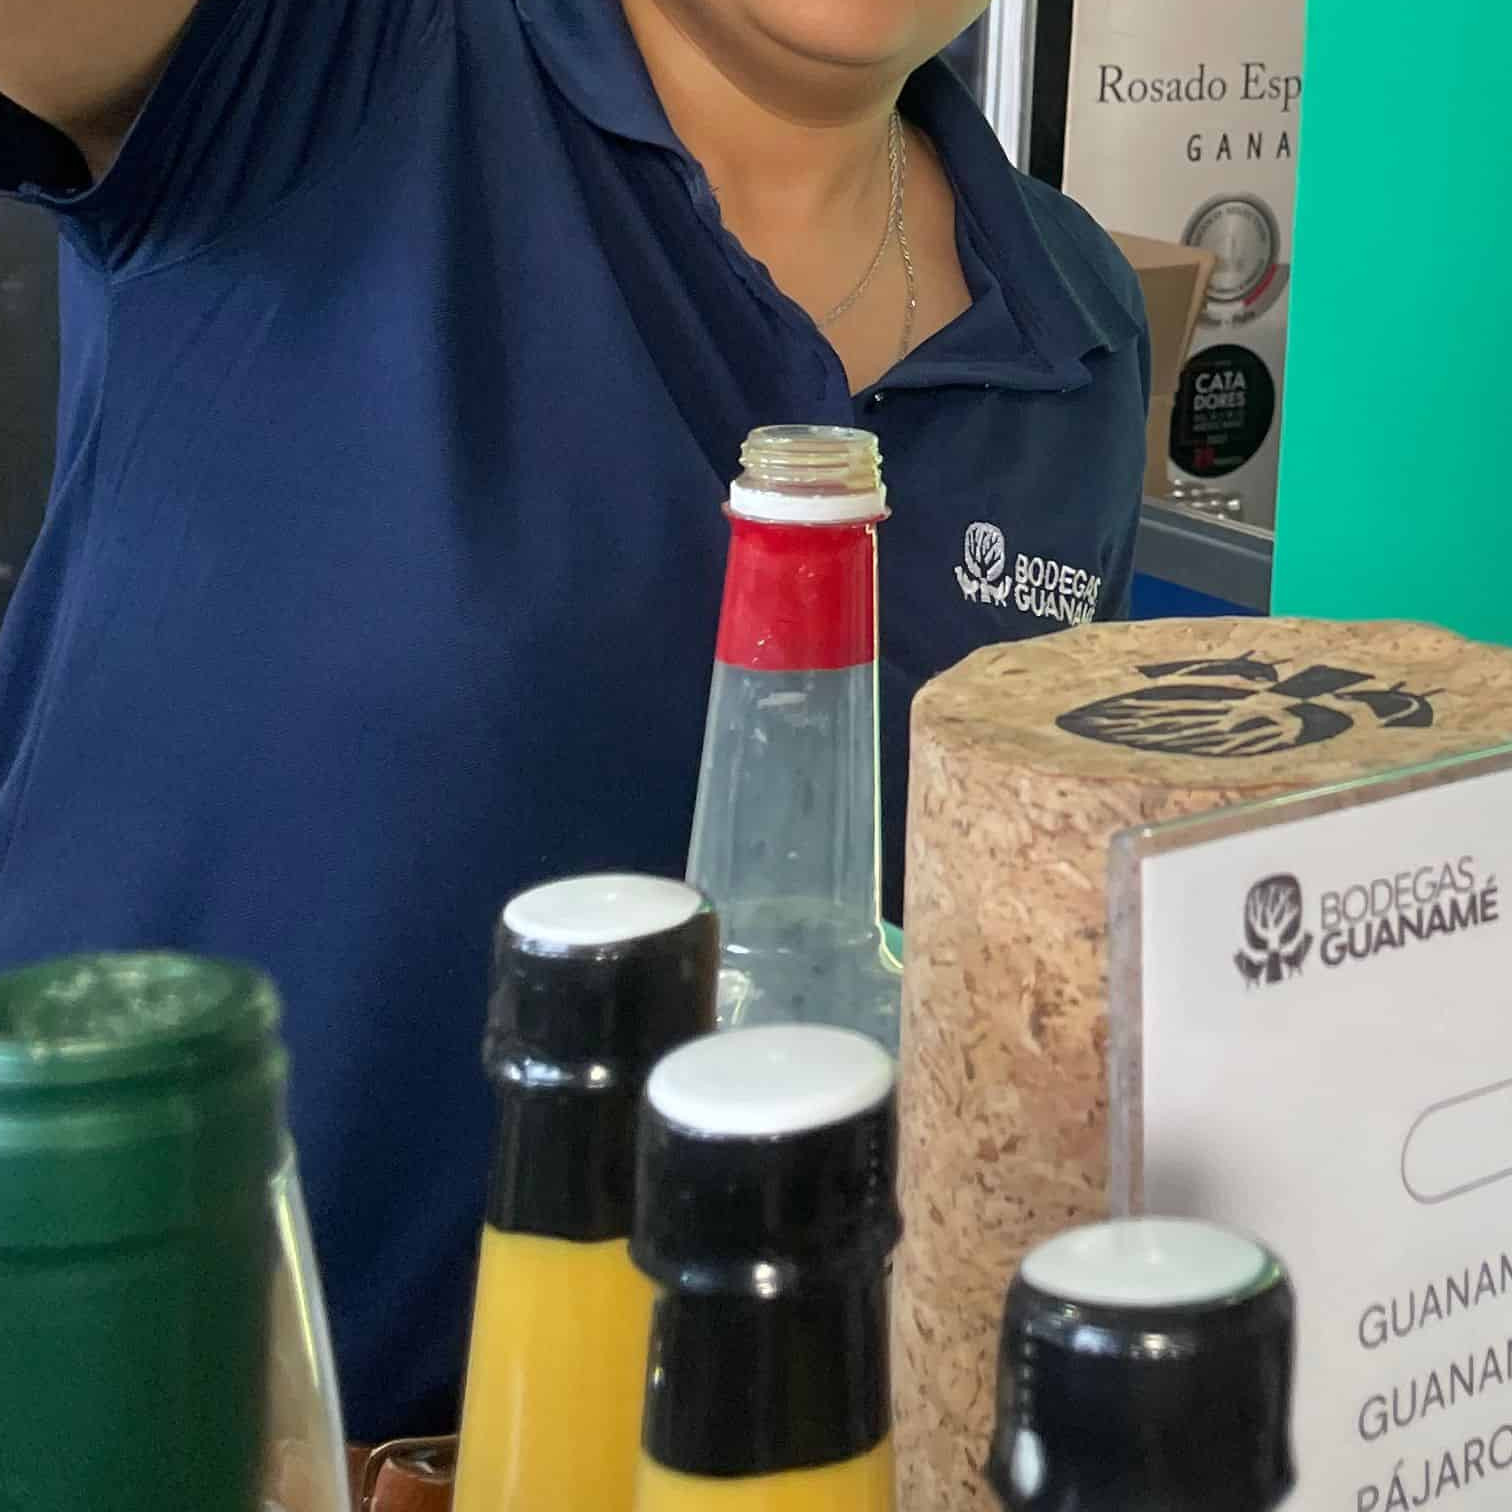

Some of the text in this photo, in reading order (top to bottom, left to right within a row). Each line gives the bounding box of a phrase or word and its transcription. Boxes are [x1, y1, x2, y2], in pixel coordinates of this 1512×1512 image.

[1097, 63, 1228, 104] Rosado
[1194, 371, 1247, 393] CATA
[1014, 553, 1101, 607] BODEGAS
[1319, 873, 1500, 966] GUANAMÉ
[1320, 855, 1475, 931] BODEGAS
